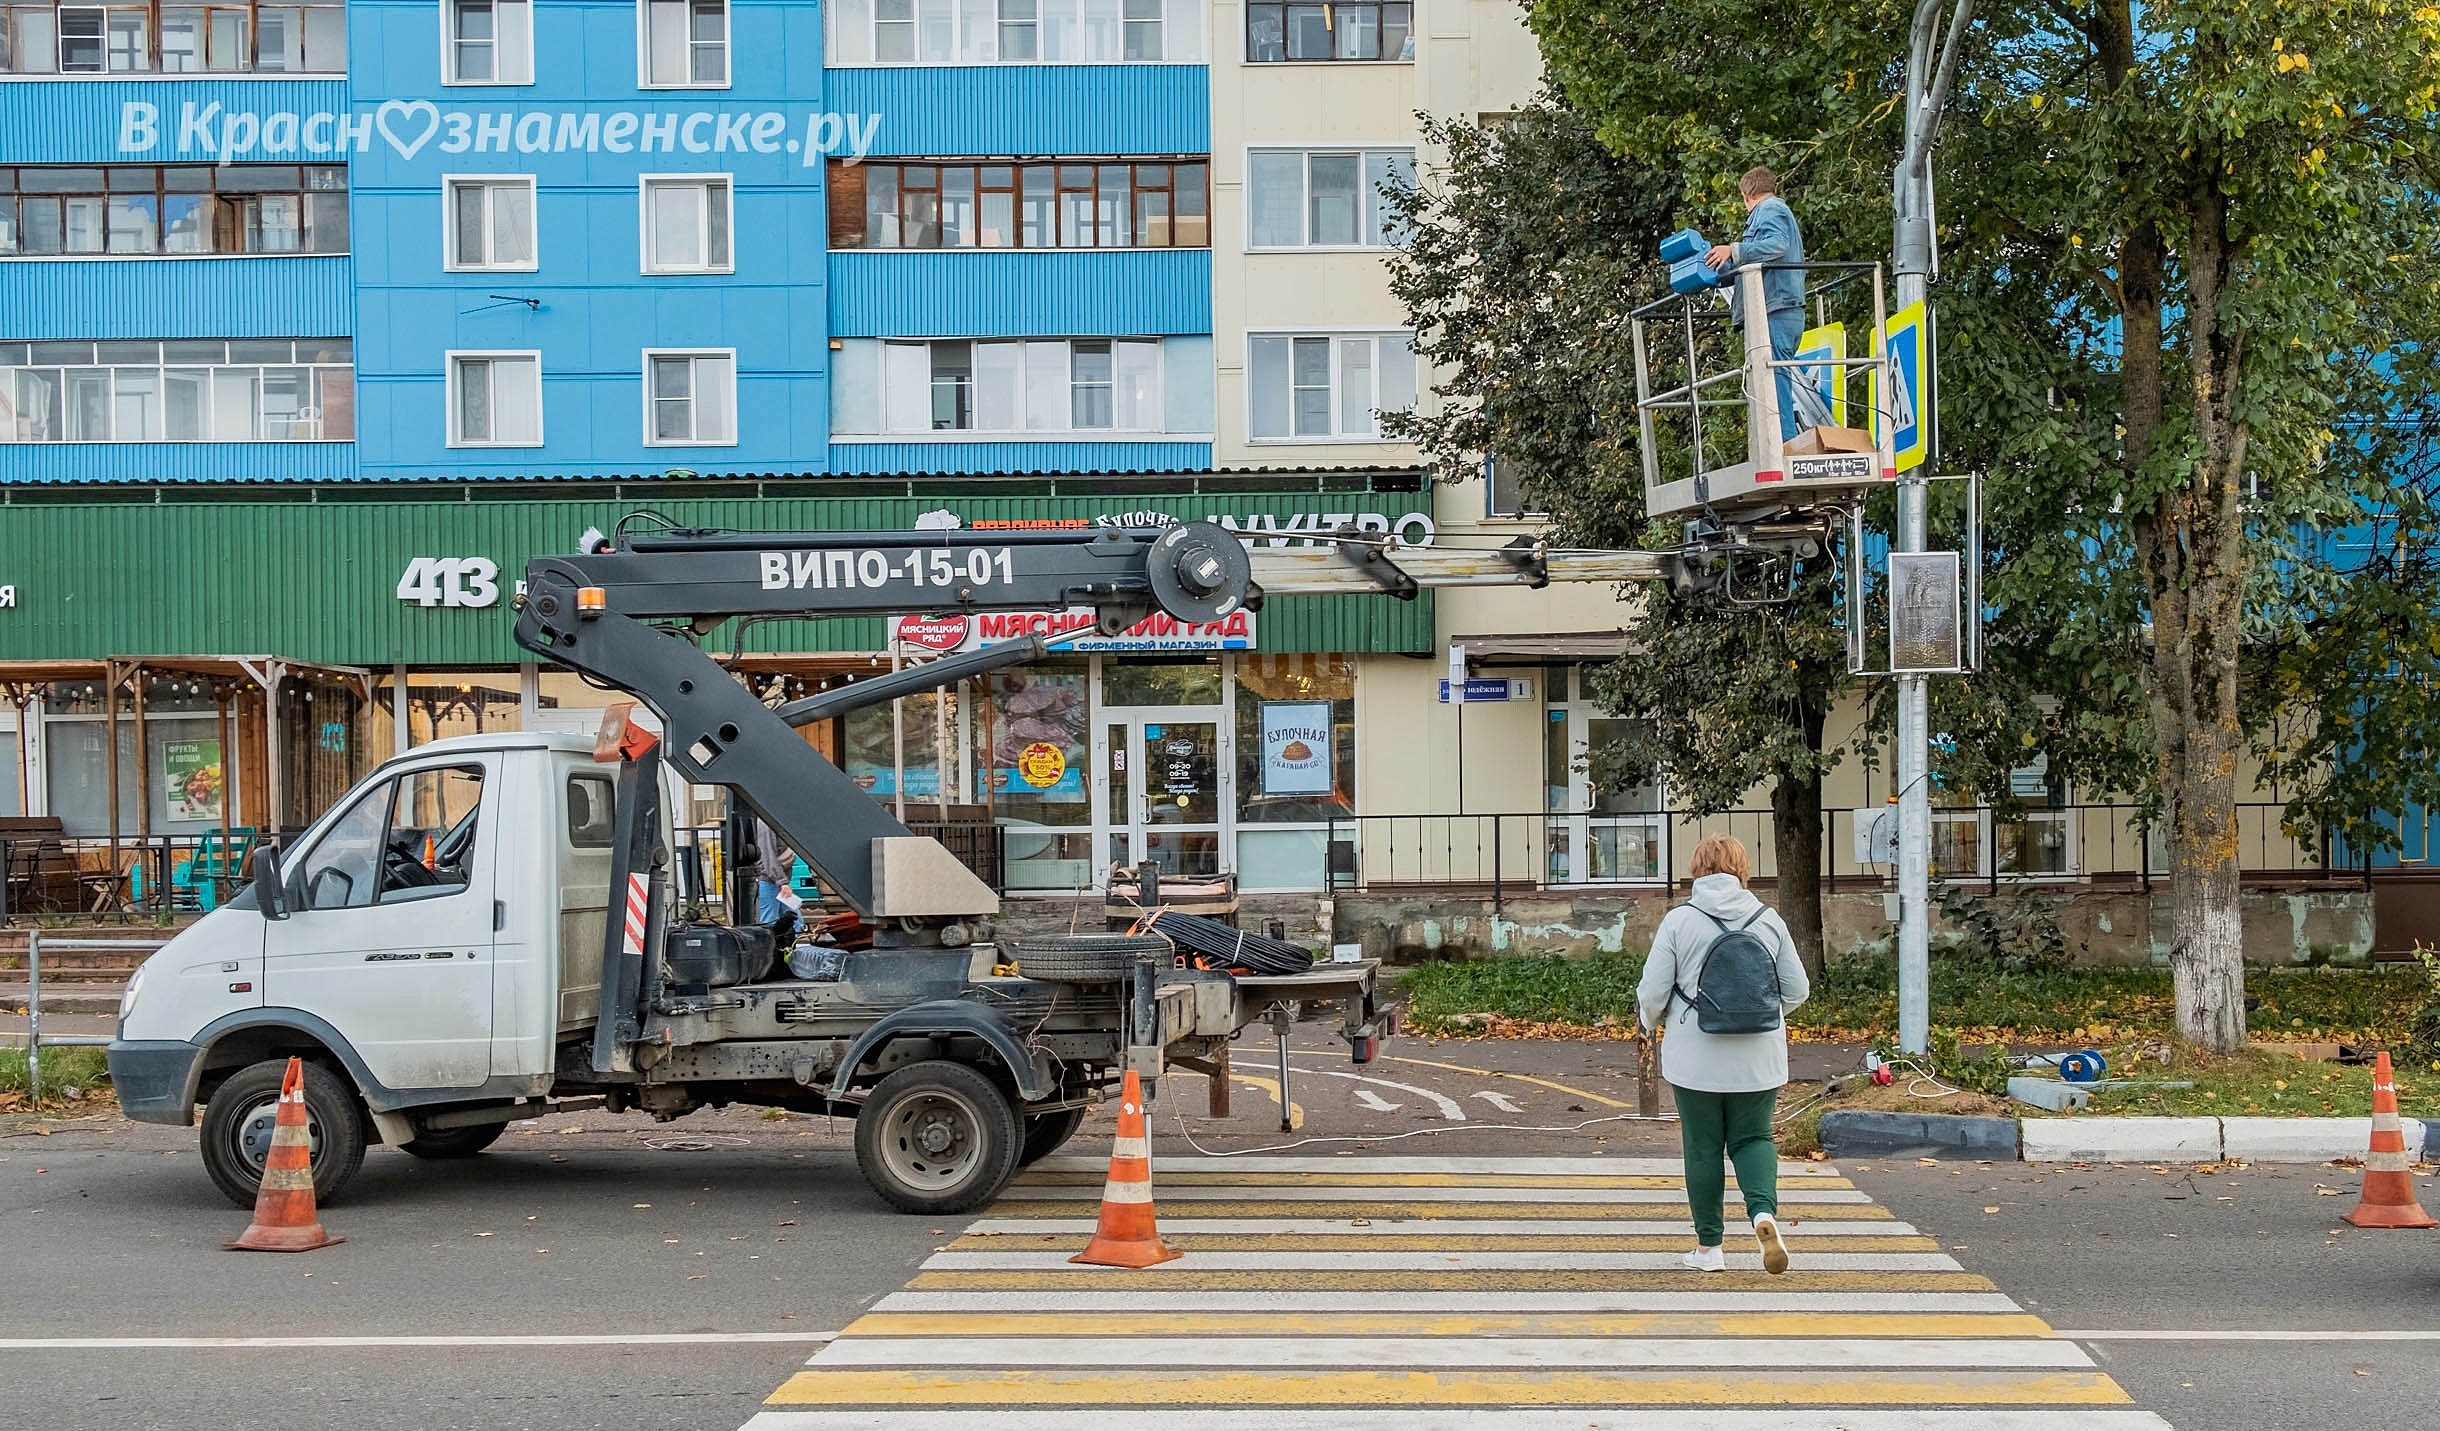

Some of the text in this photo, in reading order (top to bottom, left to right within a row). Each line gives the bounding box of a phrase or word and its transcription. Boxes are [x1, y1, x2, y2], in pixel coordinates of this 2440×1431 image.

[760, 547, 1014, 590] ВИПО-15-01
[396, 556, 500, 608] 413
[901, 622, 964, 634] МЯСНИЦКИЙ
[922, 634, 942, 643] РЯД
[1078, 640, 1217, 650] ФИРМЕННЫЙ МАГАЗИН
[1517, 682, 1524, 696] 1
[1267, 728, 1327, 744] БУЛОЧНАЯ
